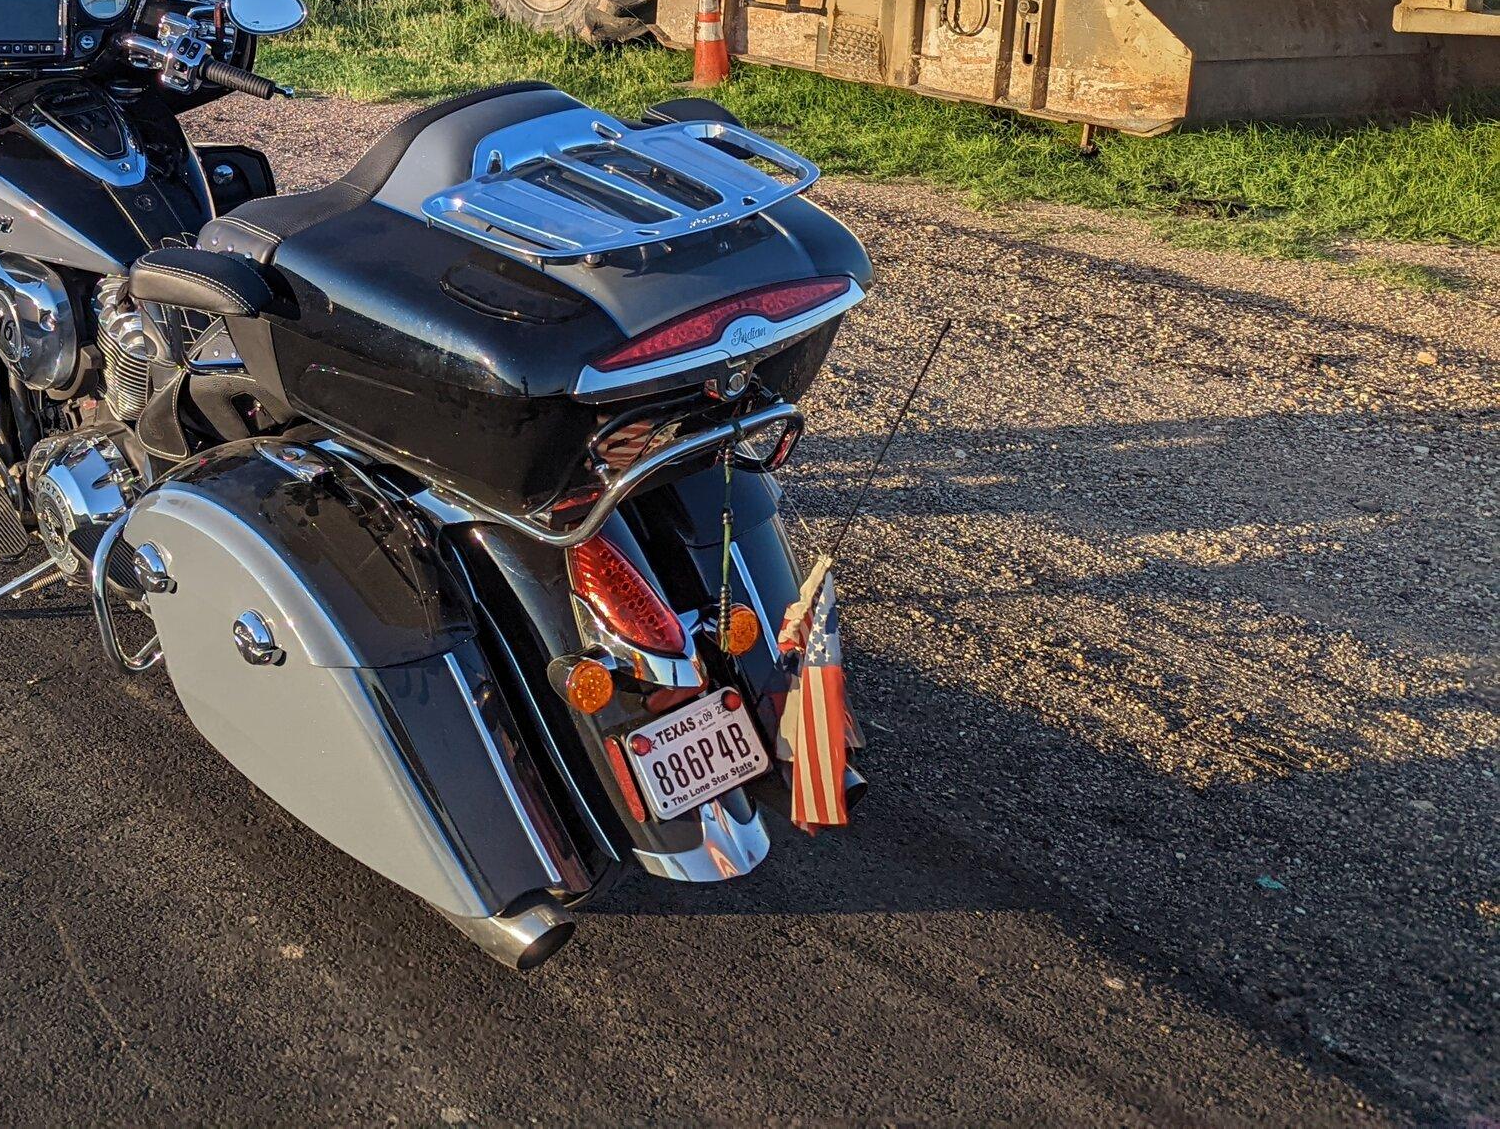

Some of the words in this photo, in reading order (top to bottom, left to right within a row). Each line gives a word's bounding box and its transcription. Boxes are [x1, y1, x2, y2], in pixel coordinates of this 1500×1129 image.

[731, 326, 766, 346] Indian
[702, 710, 713, 722] 09
[655, 717, 697, 746] TEXAS
[652, 722, 751, 796] 886P4B
[671, 793, 689, 807] The
[690, 783, 711, 798] Lone
[712, 772, 729, 786] Star
[731, 760, 753, 775] State
